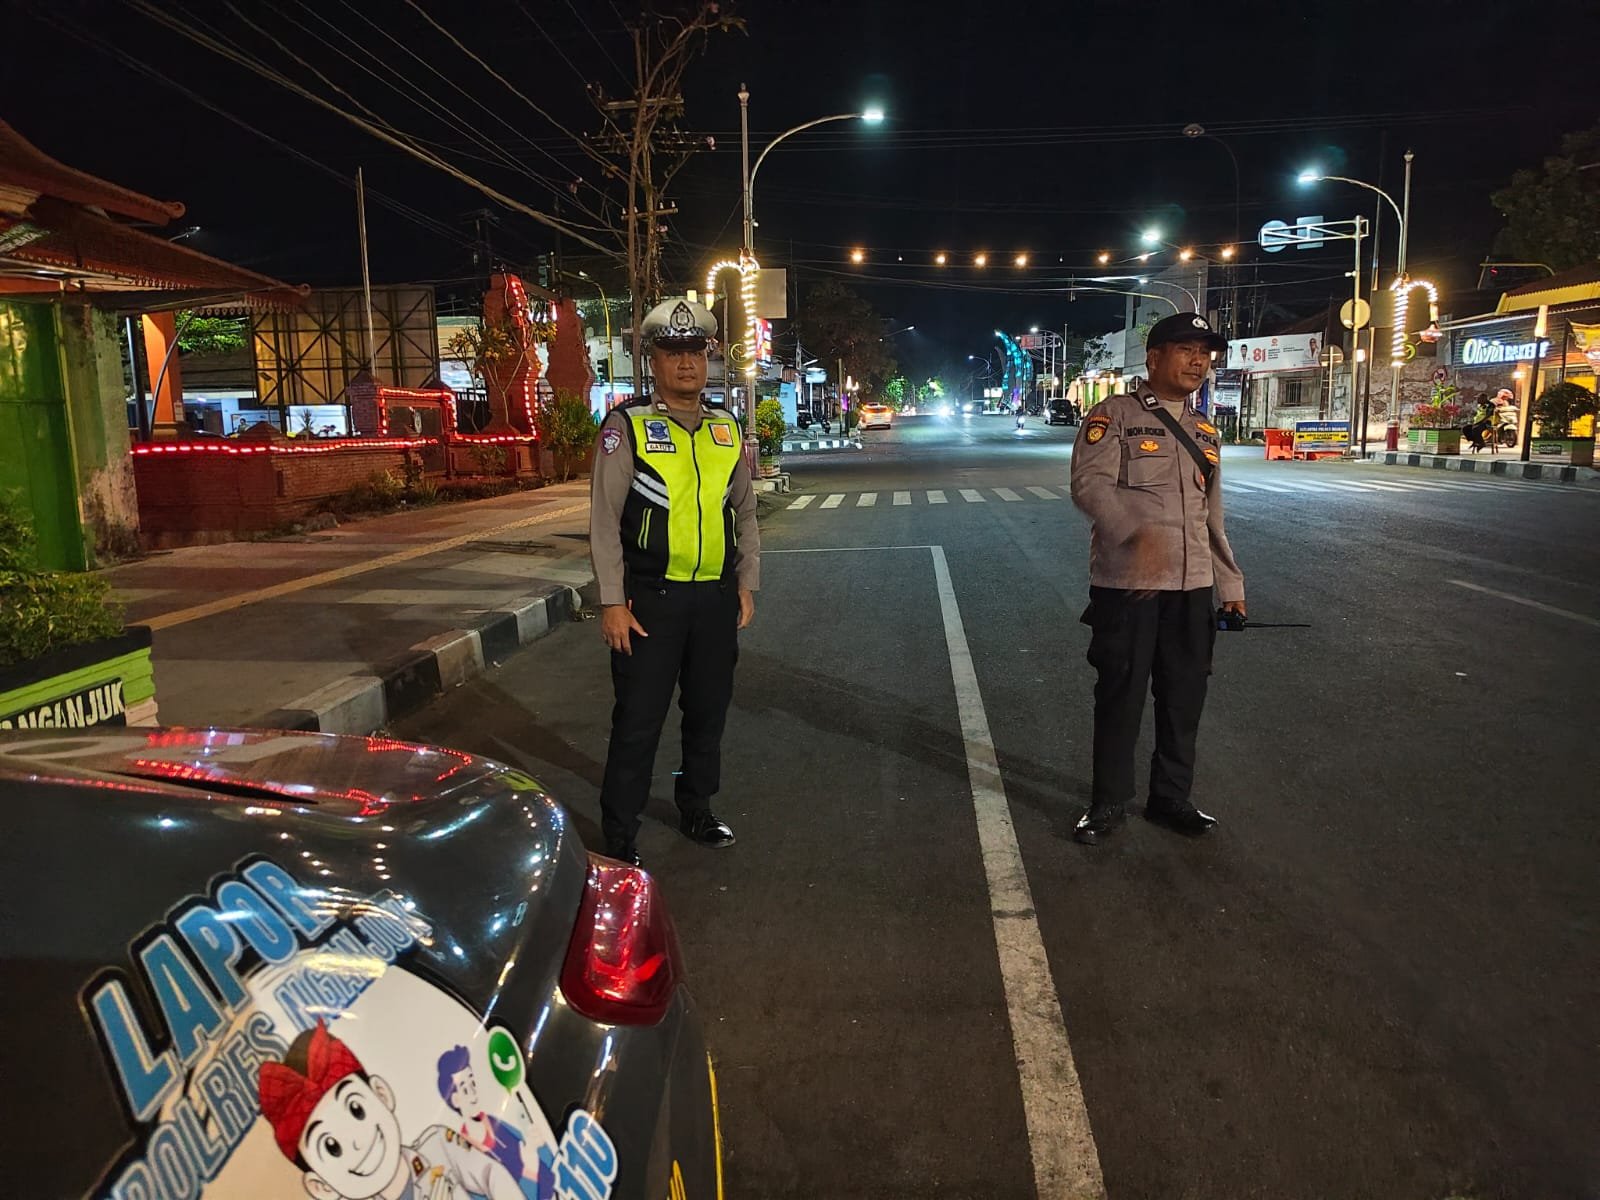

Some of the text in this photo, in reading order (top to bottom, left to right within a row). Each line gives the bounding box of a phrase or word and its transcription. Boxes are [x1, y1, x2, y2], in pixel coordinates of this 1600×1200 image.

[92, 860, 338, 1123] LAPOR
[105, 1011, 292, 1200] POLRES
[552, 1108, 619, 1200] 110
